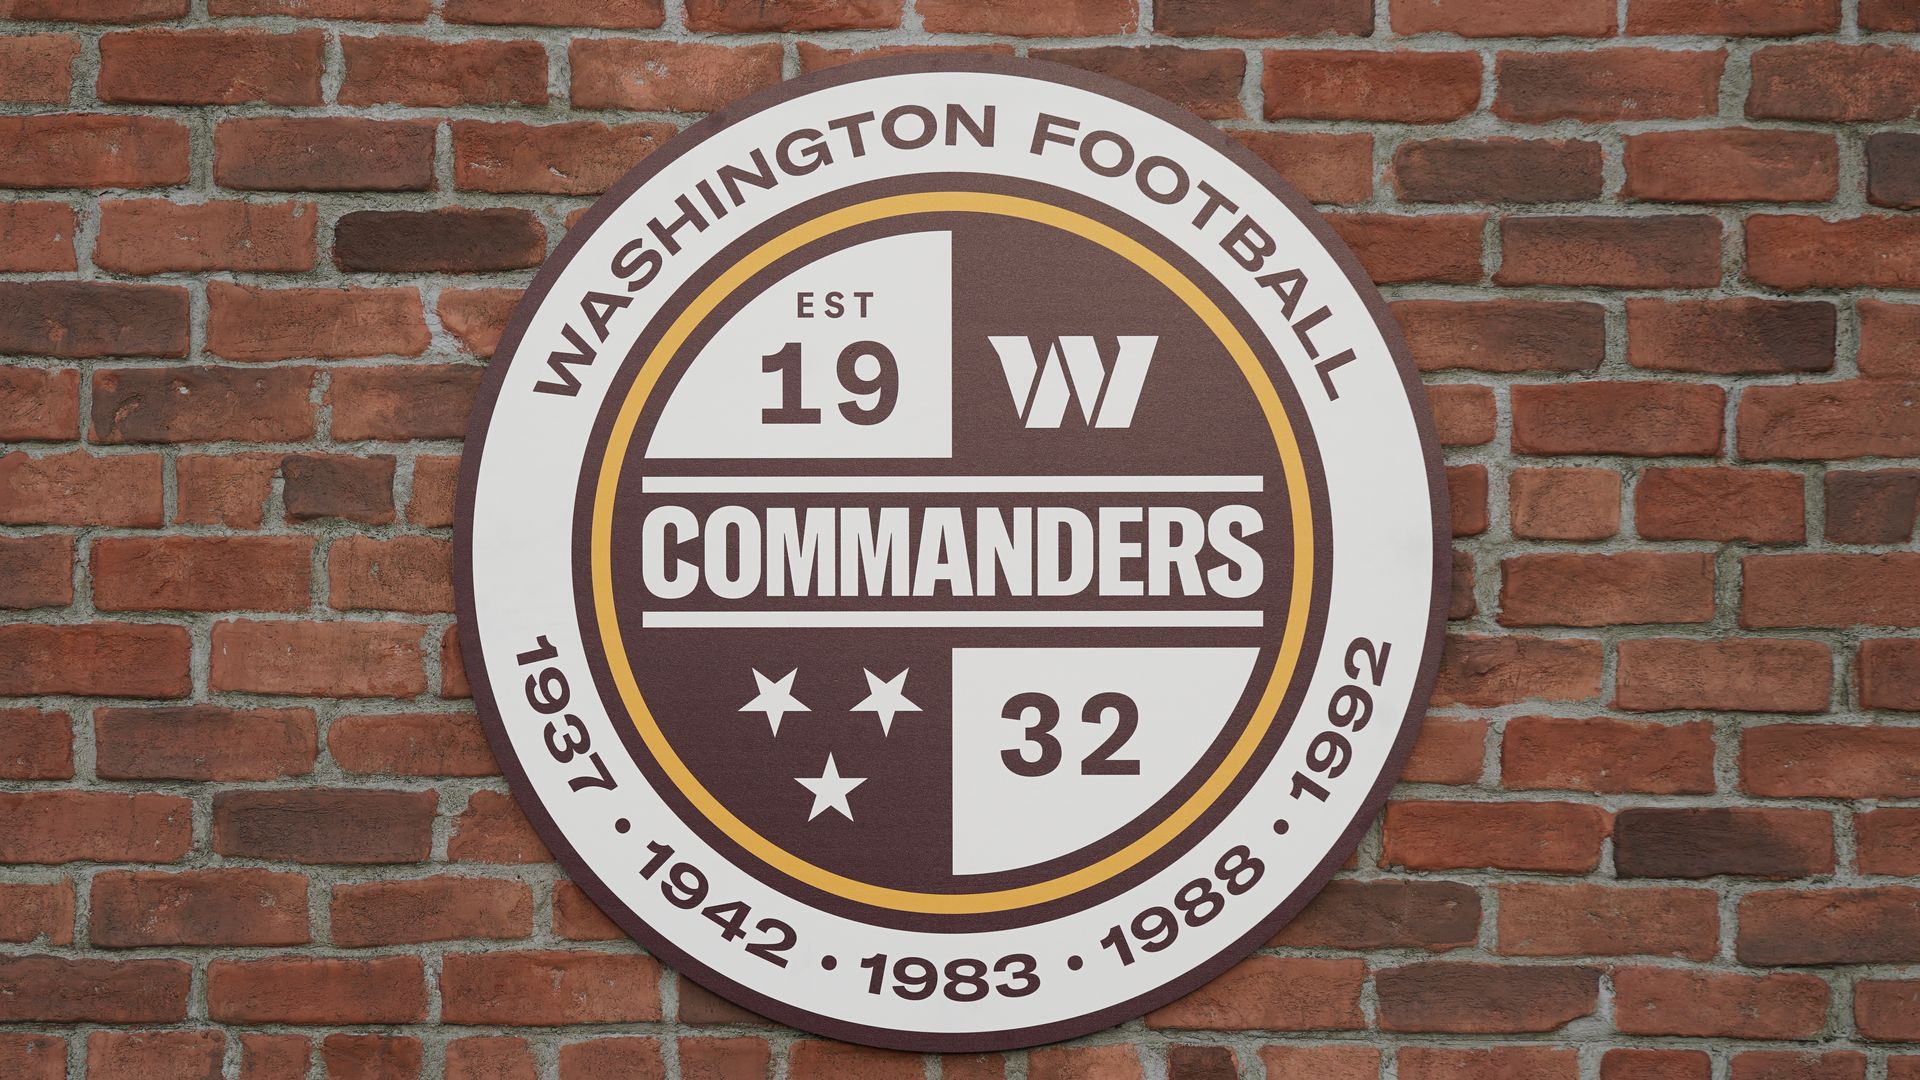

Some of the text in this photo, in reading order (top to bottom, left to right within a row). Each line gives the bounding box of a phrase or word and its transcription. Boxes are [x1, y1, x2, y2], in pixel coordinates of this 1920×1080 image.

[533, 104, 1357, 402] WASHINGTON FOOTBALL
[797, 291, 874, 319] EST
[761, 340, 899, 426] 19
[988, 335, 1160, 429] W
[642, 505, 1264, 599] COMMANDERS
[1000, 691, 1141, 778] 32
[516, 634, 1392, 1003] 1937 1942 1983 1988 1992
